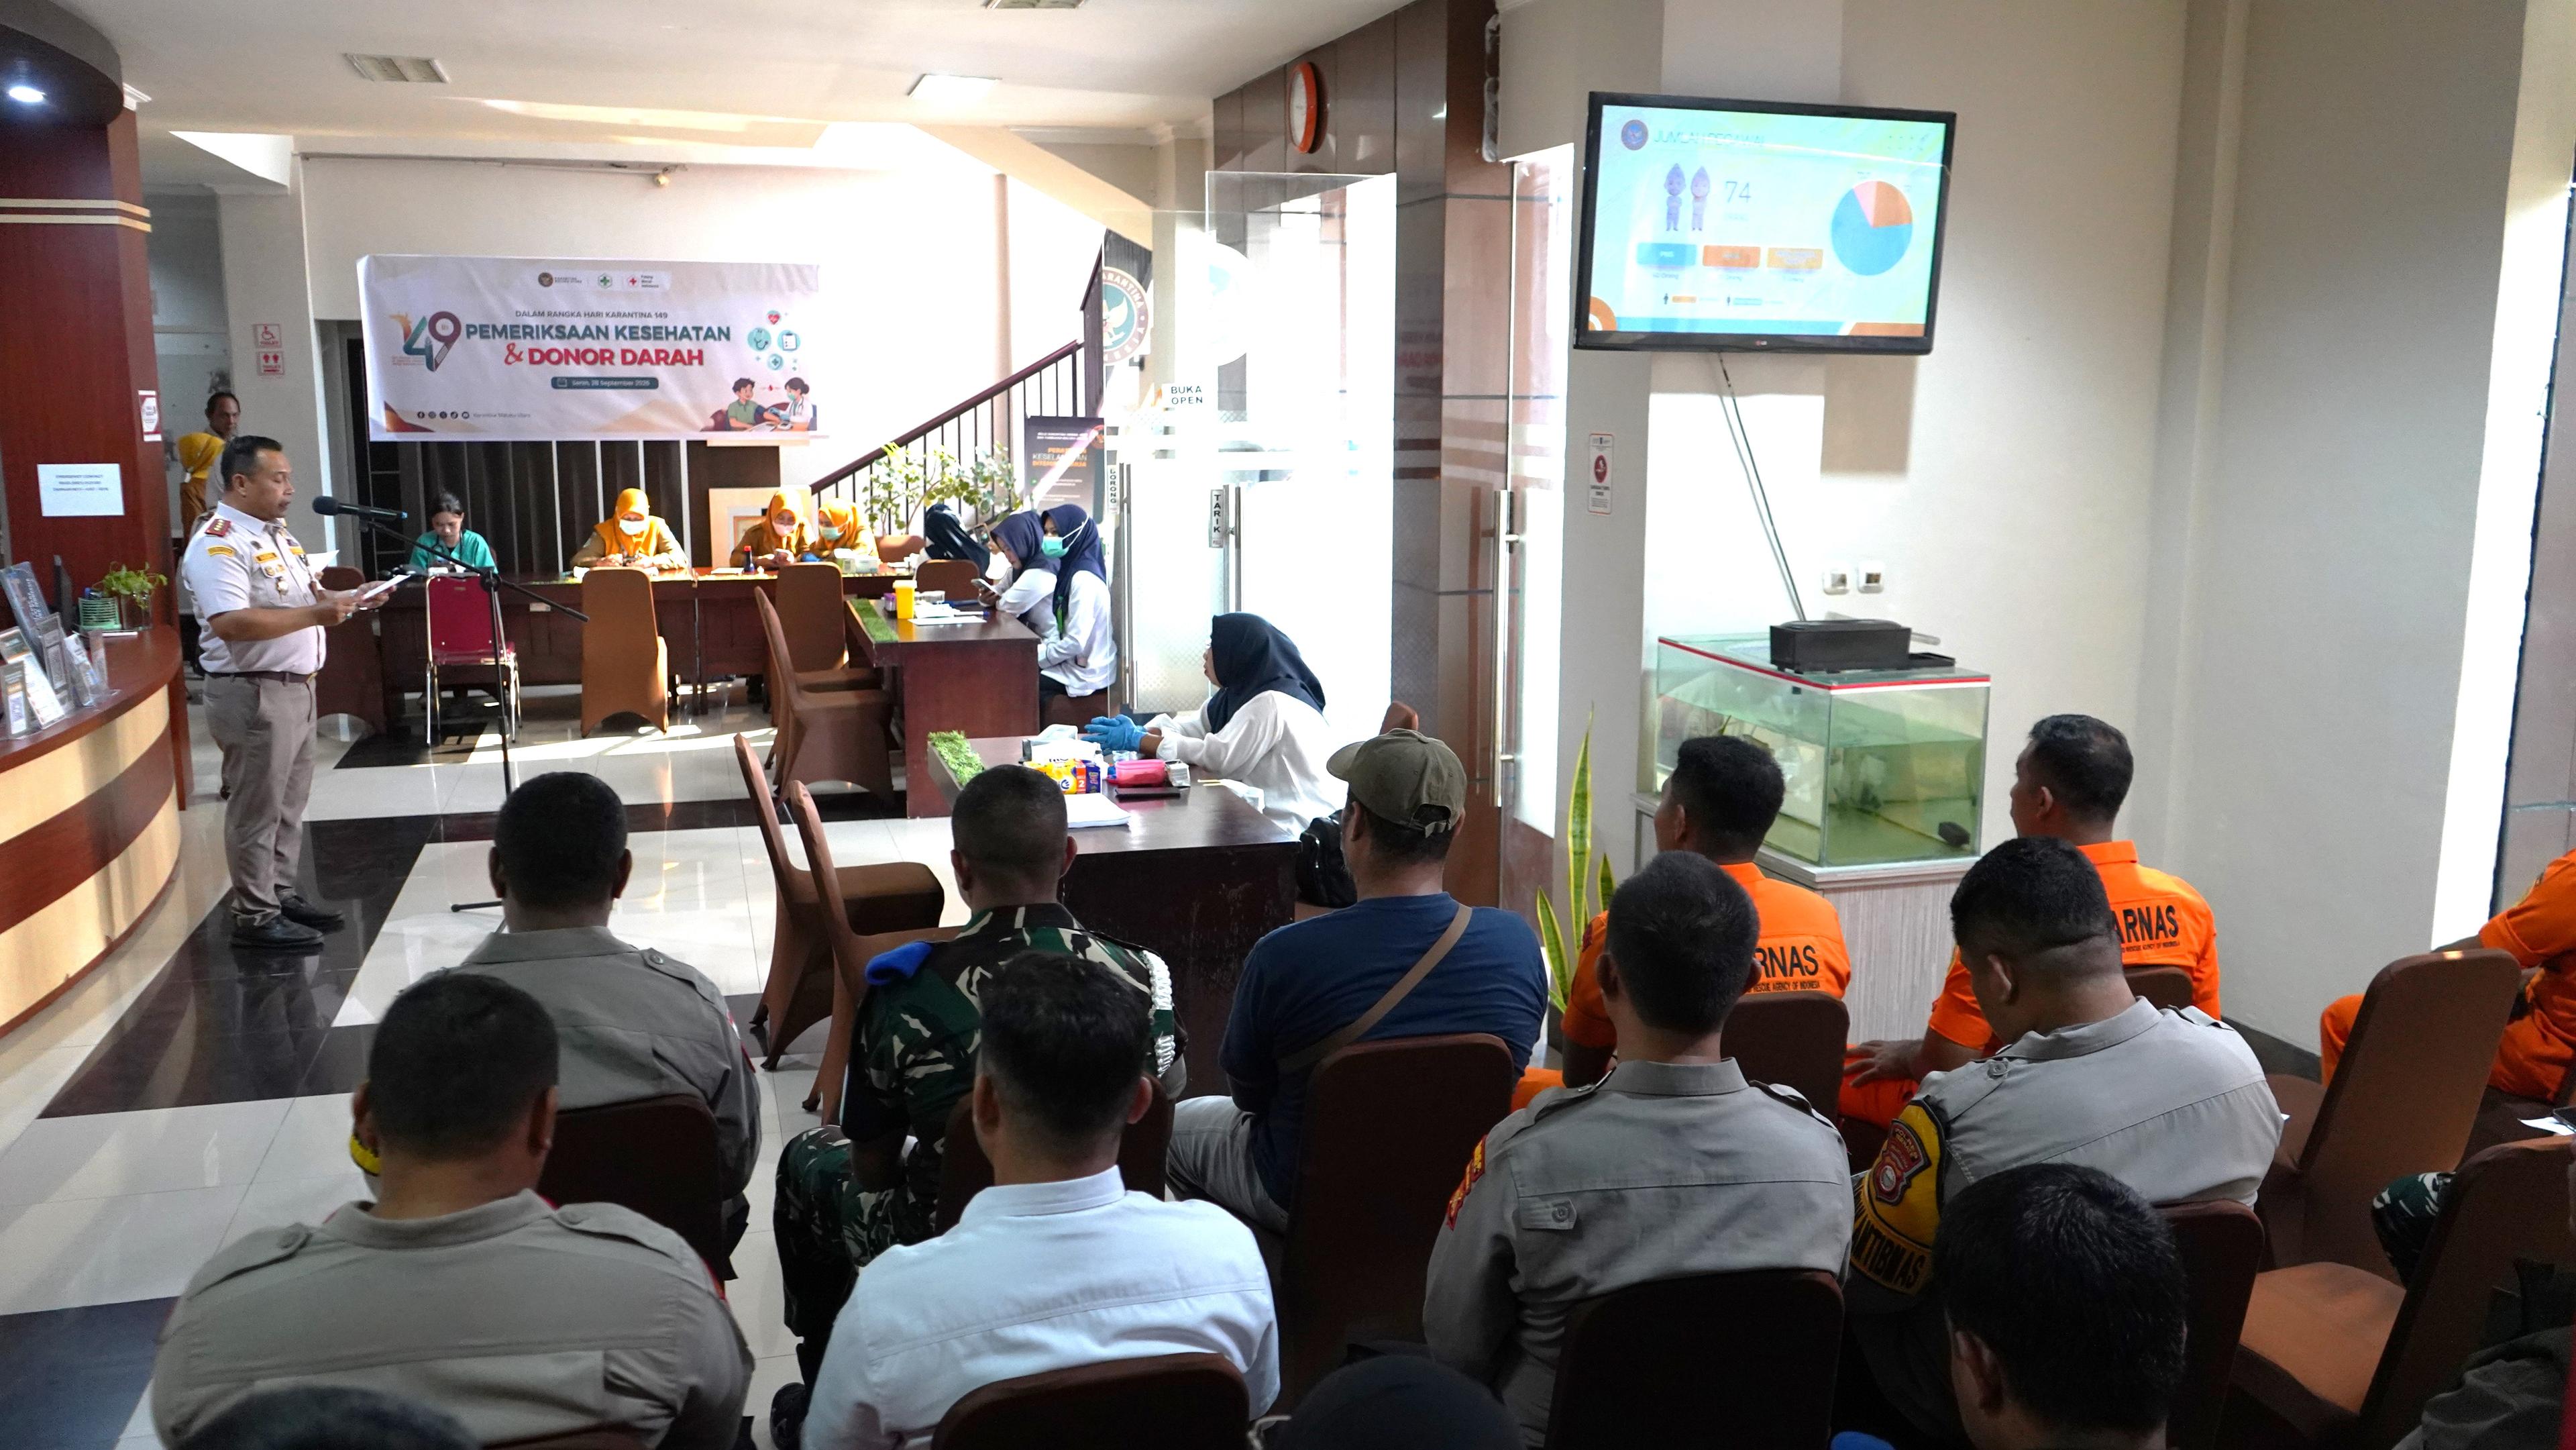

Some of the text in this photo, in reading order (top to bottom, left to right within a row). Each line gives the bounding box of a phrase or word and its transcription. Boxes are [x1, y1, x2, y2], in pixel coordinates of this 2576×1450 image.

[1726, 181, 1752, 203] 74
[1103, 272, 1144, 309] ARANTINA
[466, 323, 731, 342] PEMERIKSAAN KESEHATAN
[504, 342, 704, 366] & DONOR DARAH
[1171, 385, 1202, 394] BUKA
[1171, 397, 1203, 405] OPEN
[1214, 494, 1222, 533] TARIK
[1077, 780, 1085, 788] 2
[2111, 905, 2180, 944] ARNAS
[1754, 945, 1819, 978] RNAS
